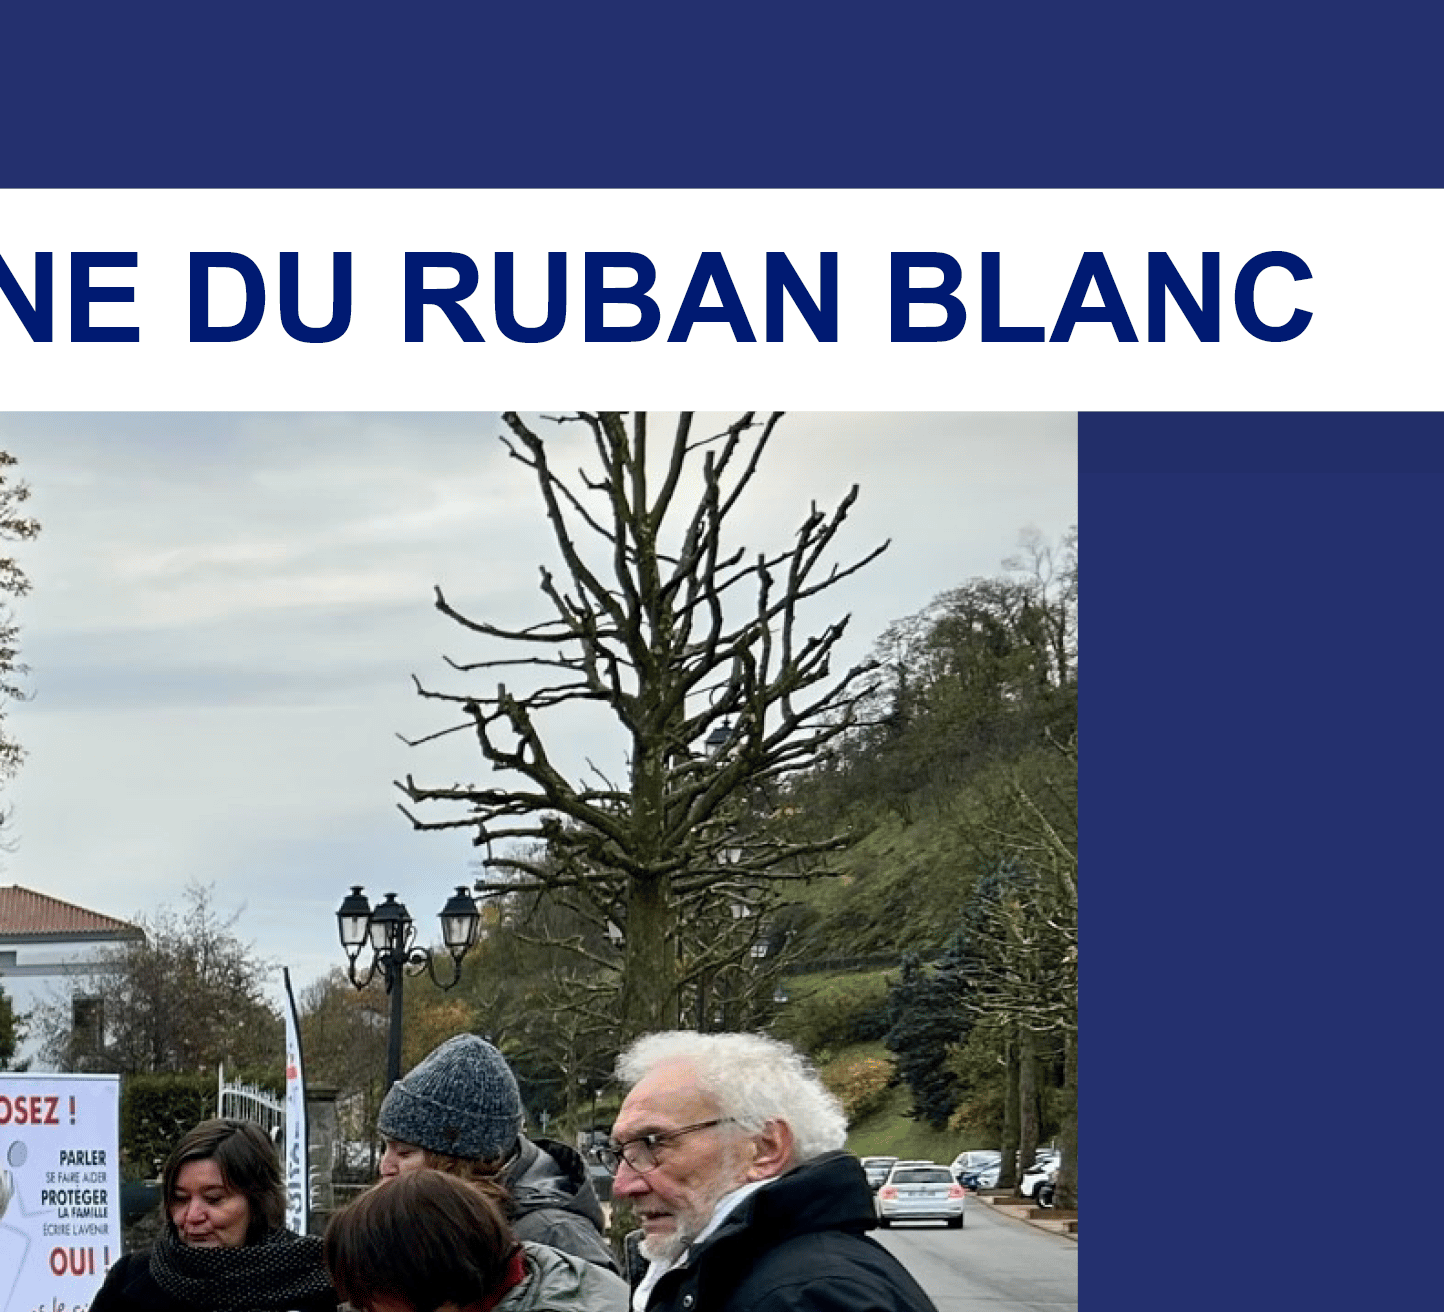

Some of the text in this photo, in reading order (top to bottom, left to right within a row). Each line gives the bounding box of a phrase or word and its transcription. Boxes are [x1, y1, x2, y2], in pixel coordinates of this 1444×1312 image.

[60, 1150, 106, 1166] PARLER
[46, 1172, 107, 1184] SE FAIRE AIDER
[58, 1207, 108, 1218] LA FAMILLE
[50, 1246, 94, 1276] OUI
